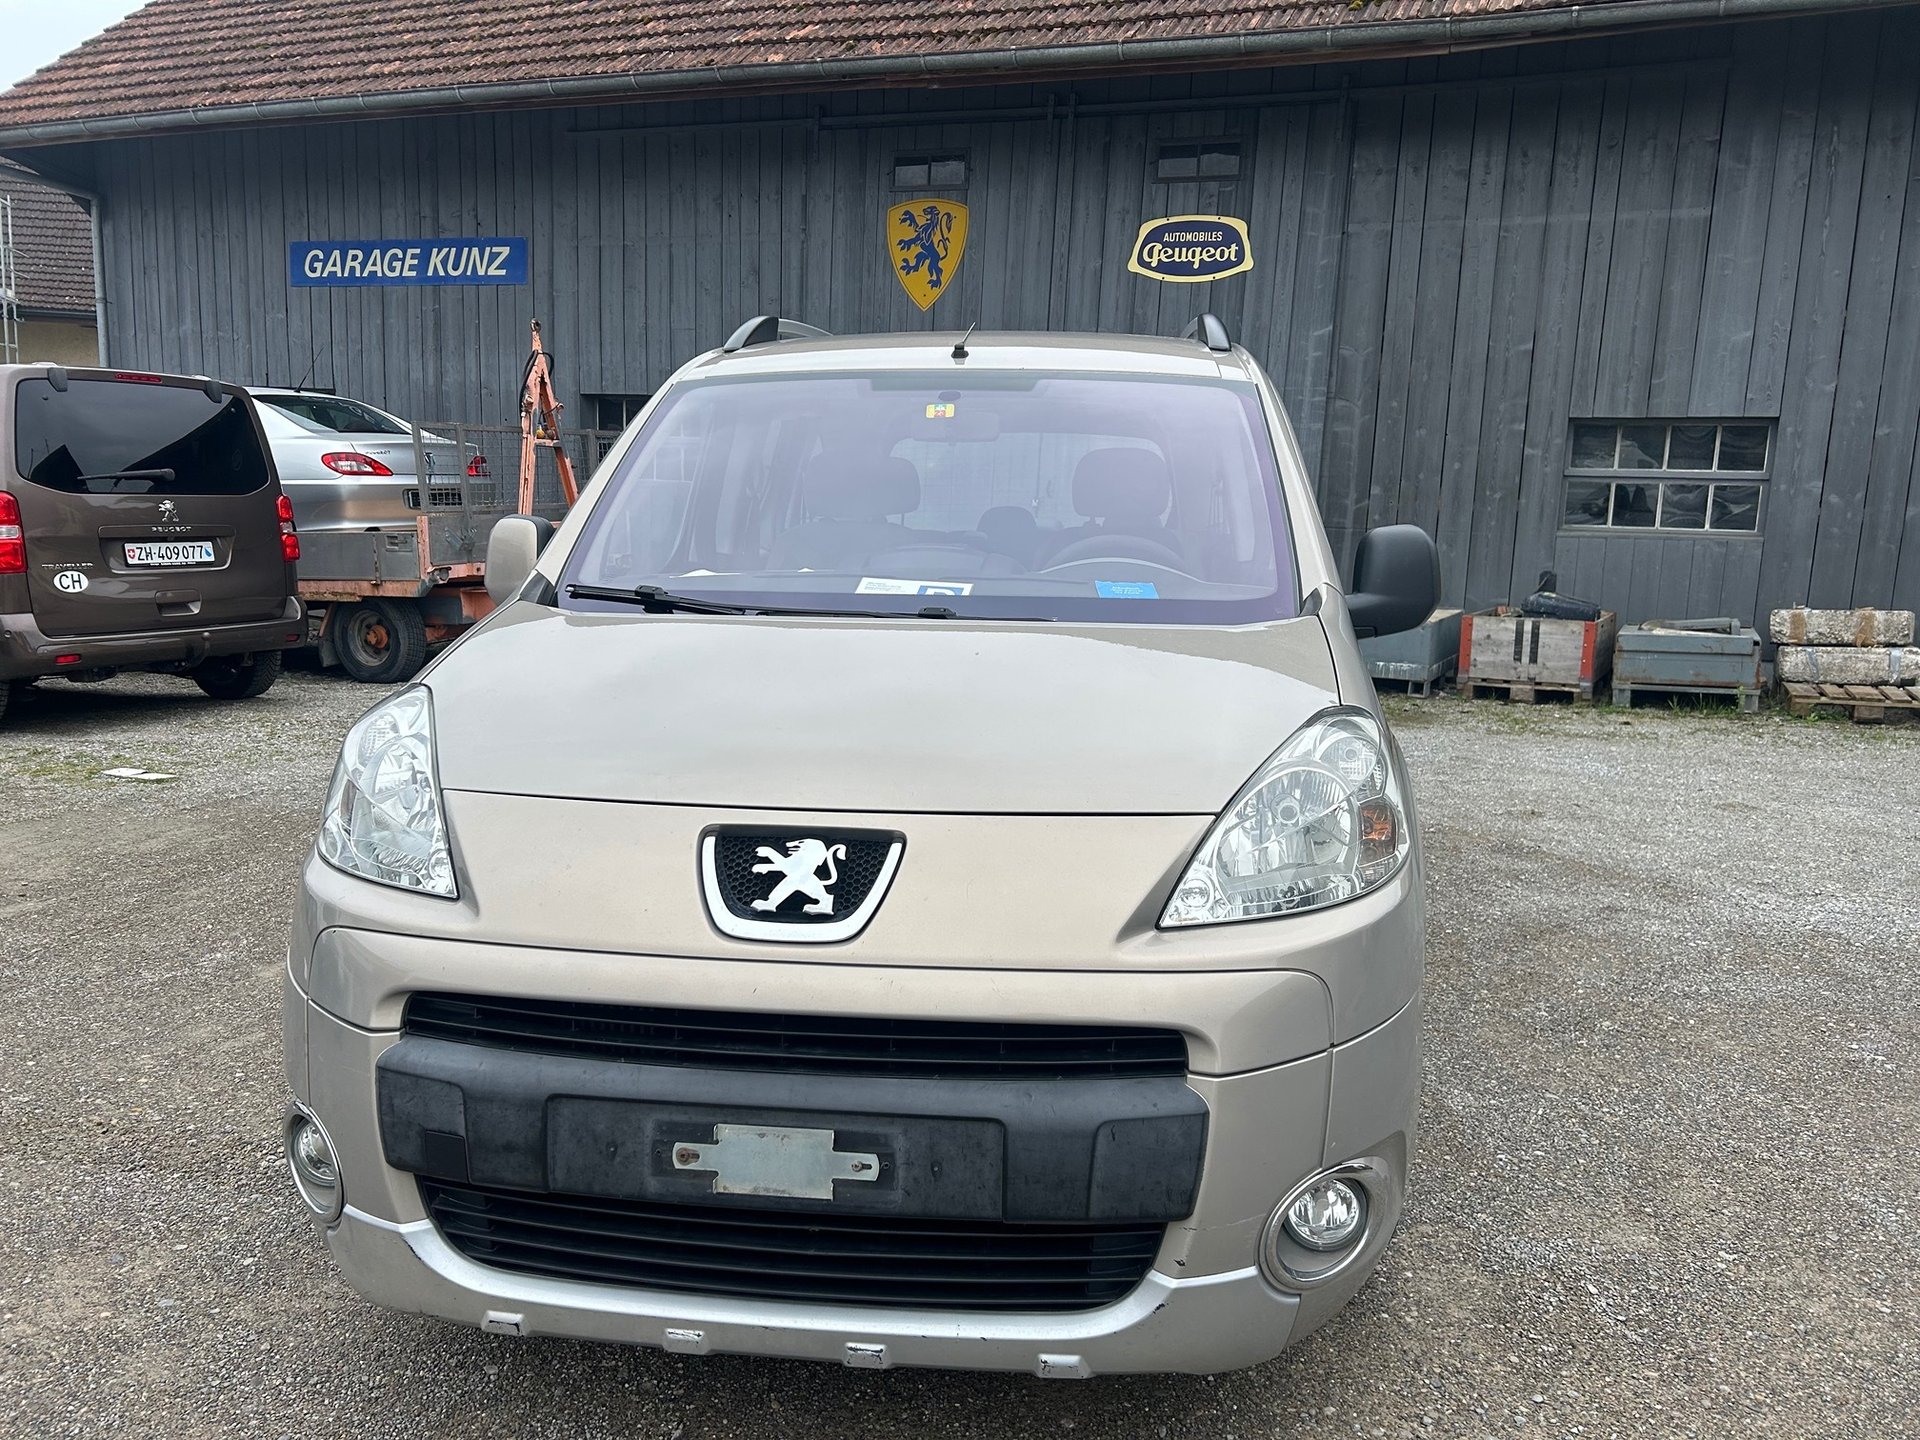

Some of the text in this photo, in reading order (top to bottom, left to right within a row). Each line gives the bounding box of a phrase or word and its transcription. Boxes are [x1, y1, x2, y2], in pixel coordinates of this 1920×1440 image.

[1163, 231, 1223, 242] AUTOMOBILES
[304, 246, 511, 278] GARAGE KUNZ
[1142, 242, 1239, 270] Peugeot
[59, 573, 82, 590] CH
